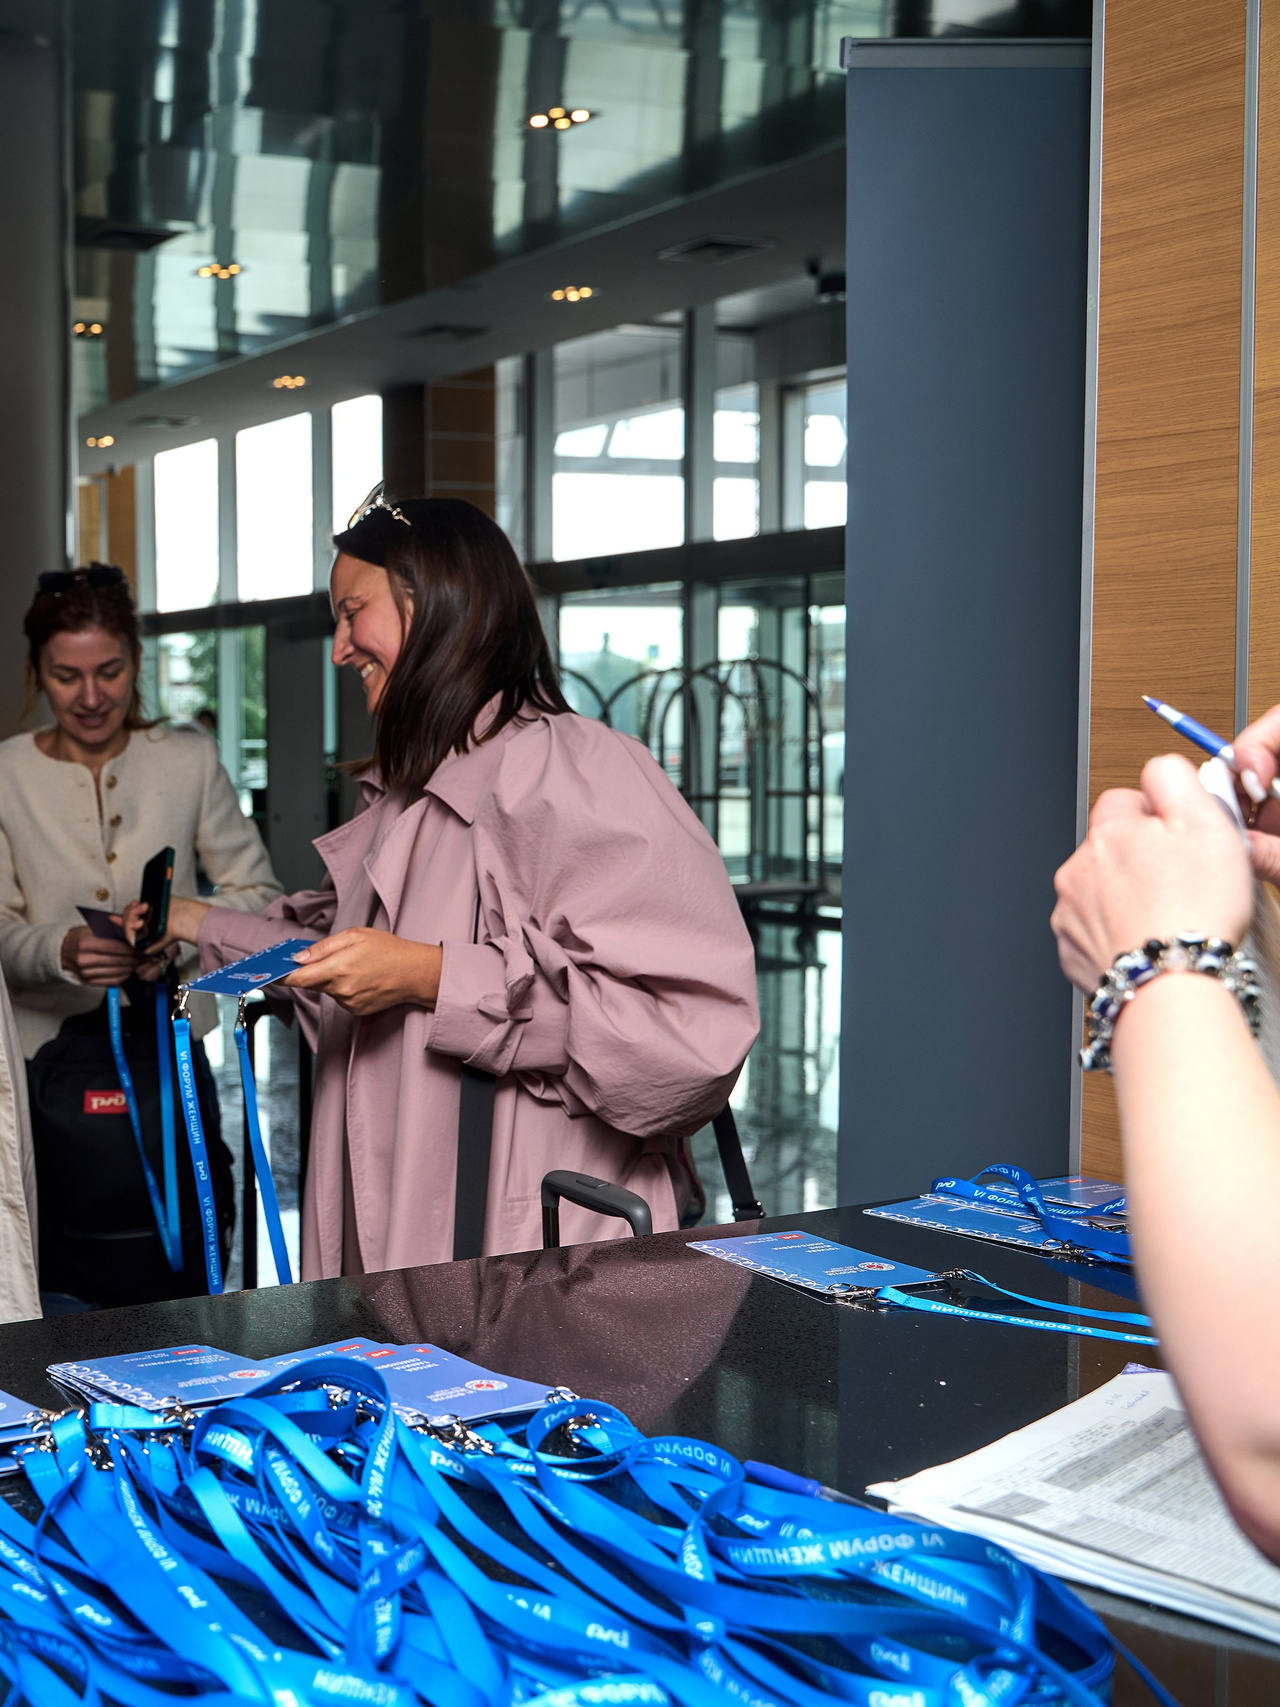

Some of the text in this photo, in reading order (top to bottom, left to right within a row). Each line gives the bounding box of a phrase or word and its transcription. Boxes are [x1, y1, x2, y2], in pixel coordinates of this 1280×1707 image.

[179, 1050, 188, 1061] VI
[181, 1063, 194, 1099] ФОРУМ
[187, 1101, 202, 1145] ЖЕНЩИН
[973, 1189, 985, 1198] VI
[203, 1196, 220, 1286] VI ФОРУМ ЖЕНЩИН
[930, 1304, 1005, 1320] ЖЕНЩИН
[1009, 1316, 1071, 1331] ФОРУМ
[653, 1442, 717, 1467] ФОРУМ
[271, 1455, 302, 1504] ФОРУМ
[137, 1528, 168, 1559] ФОРУМ
[728, 1533, 946, 1566] VI ФОРУМ ЖЕНЩИН
[871, 1559, 968, 1607] ЖЕНЩИН
